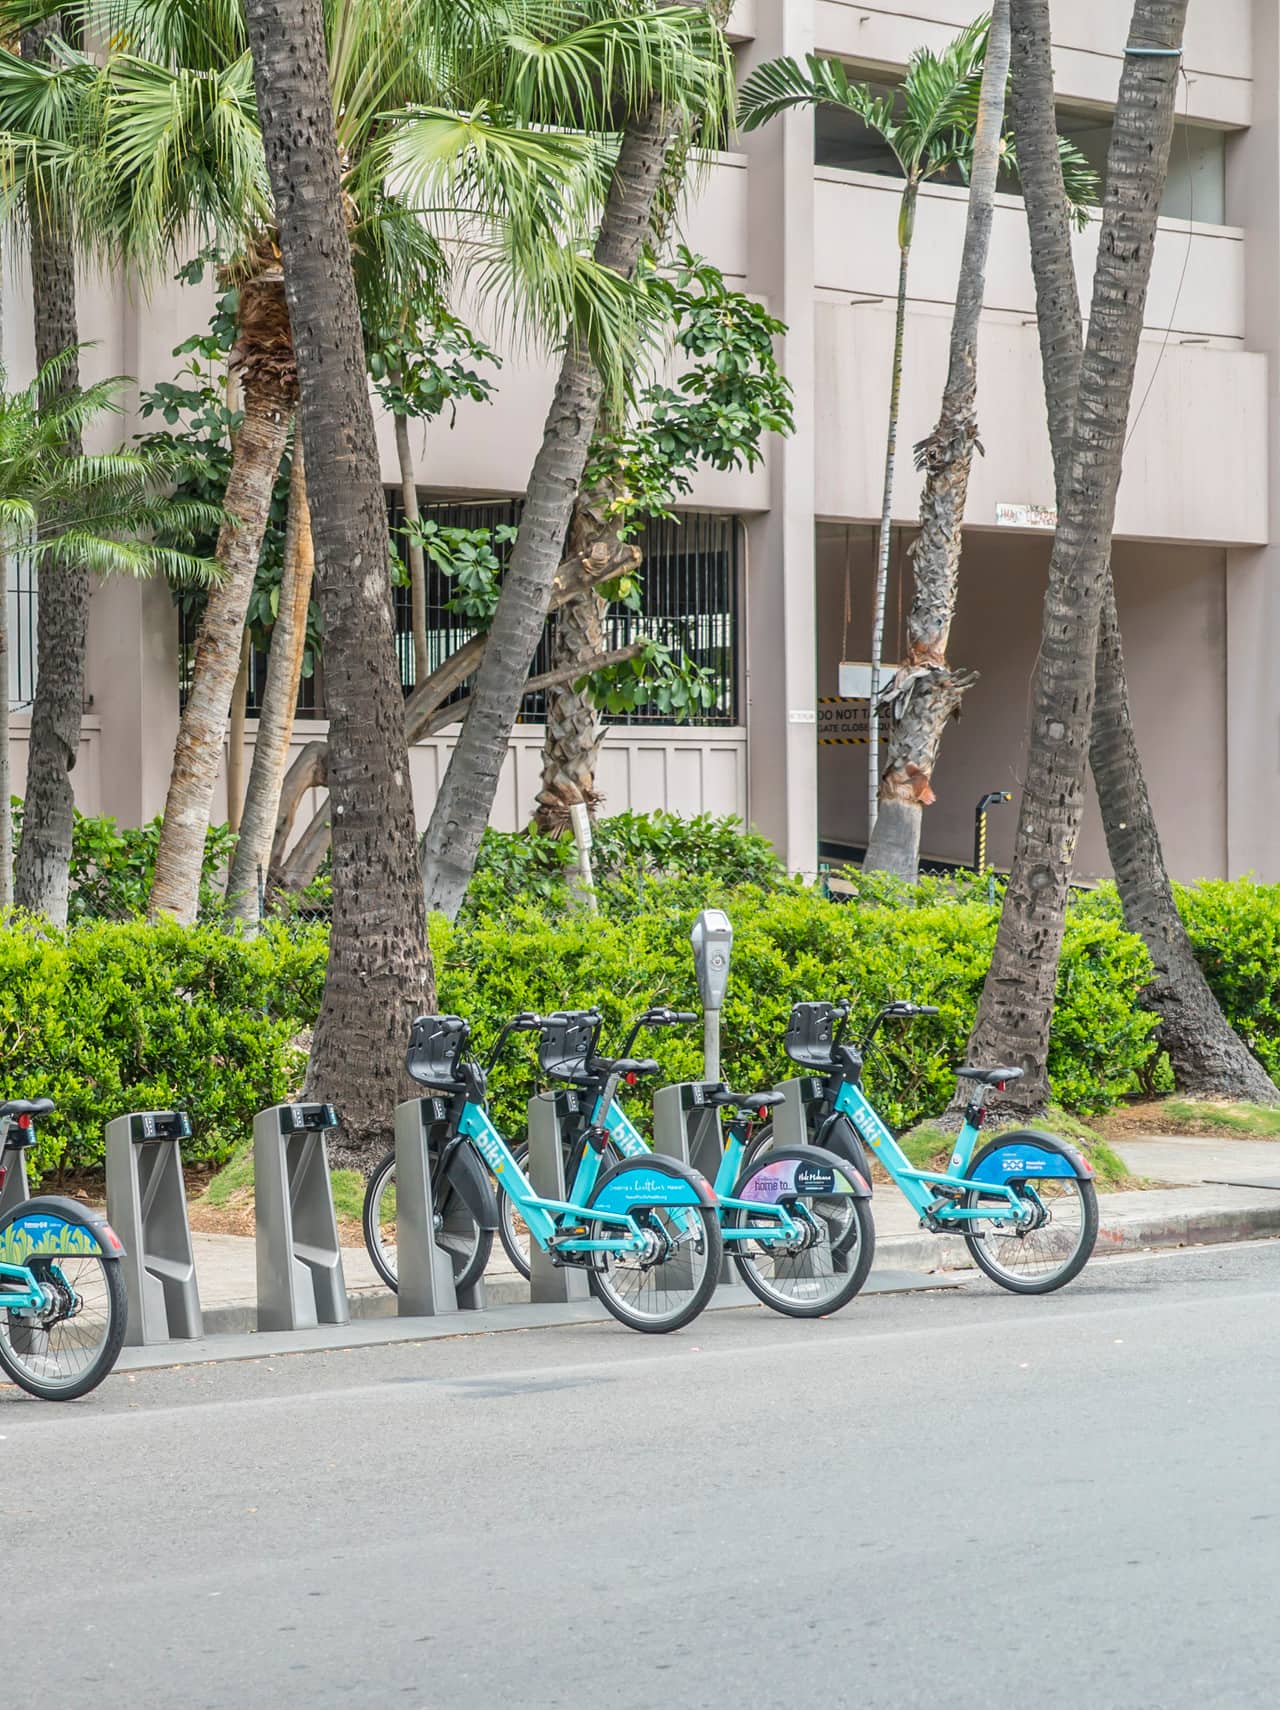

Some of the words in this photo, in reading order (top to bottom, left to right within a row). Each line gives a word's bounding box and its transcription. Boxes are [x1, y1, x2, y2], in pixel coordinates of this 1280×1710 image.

[835, 709, 859, 720] NOT
[853, 1106, 881, 1142] biki
[476, 1128, 504, 1168] biki
[754, 1181, 778, 1191] home
